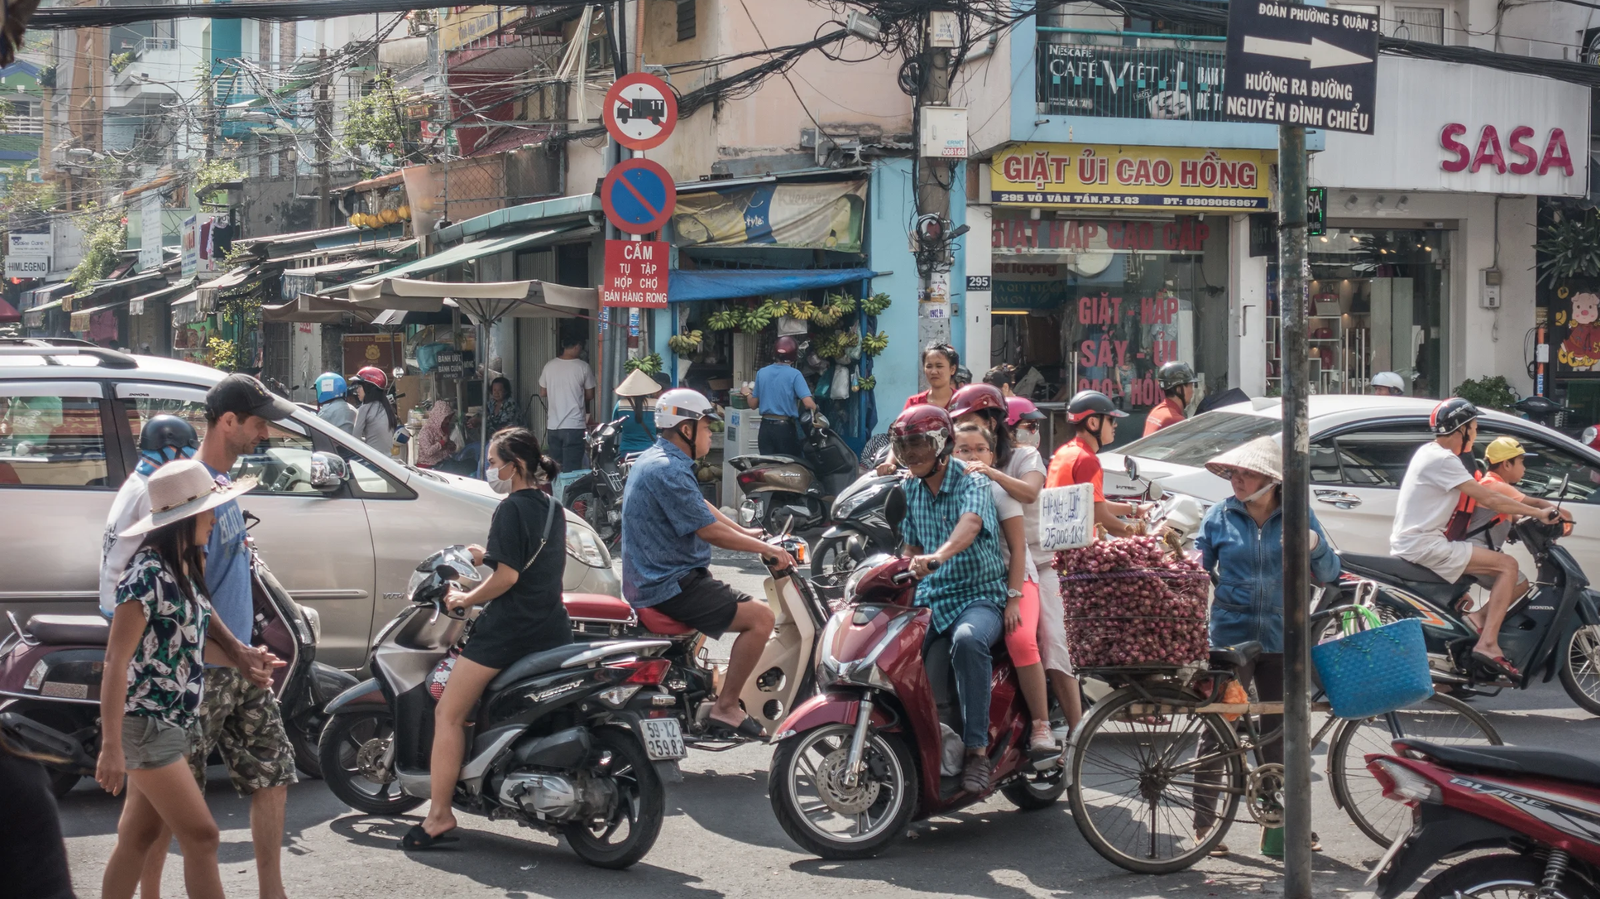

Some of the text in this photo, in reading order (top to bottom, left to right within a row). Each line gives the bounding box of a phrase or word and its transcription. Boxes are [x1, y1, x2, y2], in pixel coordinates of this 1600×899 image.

[1258, 0, 1378, 32] ĐOÀN PHƯỜNG 5 QUẬN 3
[1245, 70, 1353, 101] HƯỚNG RA ĐƯỜNG
[1227, 92, 1369, 132] NGUYỄN ĐÌNH CHIỂU
[1439, 123, 1574, 177] SASA
[1003, 151, 1068, 189] GIẶT
[1116, 158, 1172, 185] CAO
[1180, 151, 1257, 188] HỒNG
[1001, 194, 1024, 202] 295
[1027, 193, 1043, 202] VÕ
[1186, 198, 1258, 207] 0909066967
[1107, 222, 1154, 250] CAO
[624, 242, 653, 260] CẤM
[614, 276, 658, 291] HỢP CHỢ
[619, 262, 657, 276] TỤ TẬP
[969, 276, 988, 287] 295
[604, 290, 667, 303] BÁN HÀNG RONG
[1079, 291, 1122, 331] GIẶT
[1141, 288, 1178, 325] HẤP
[1080, 330, 1128, 368] SẤY
[1153, 331, 1177, 367] ỦI
[1131, 369, 1166, 405] HỒN
[646, 721, 677, 738] 59-X2
[648, 739, 685, 756] 359.83
[1450, 777, 1551, 810] BLADE
